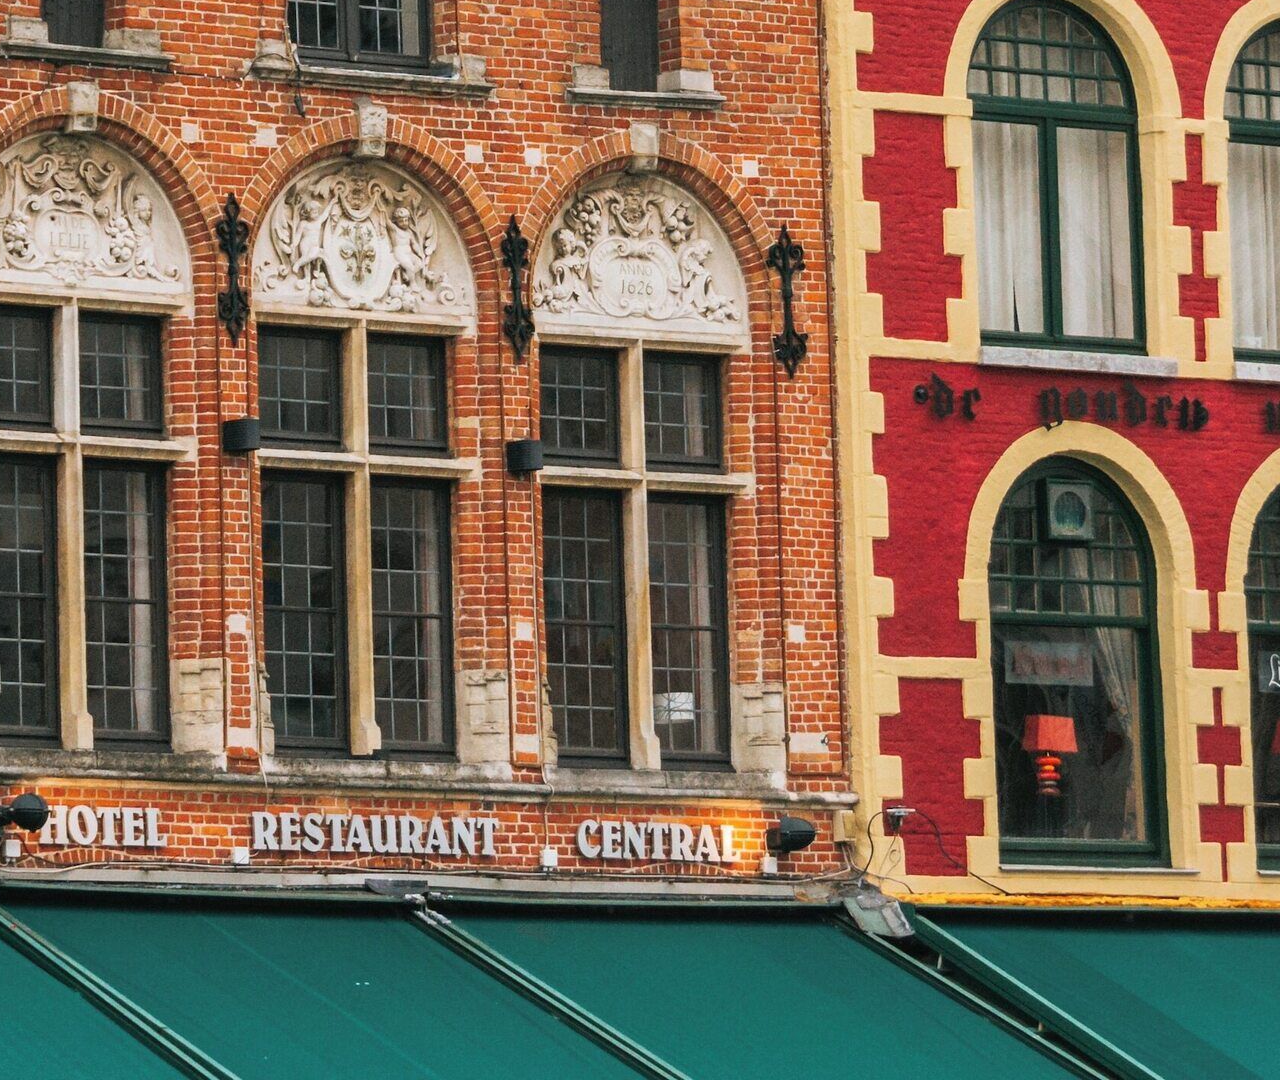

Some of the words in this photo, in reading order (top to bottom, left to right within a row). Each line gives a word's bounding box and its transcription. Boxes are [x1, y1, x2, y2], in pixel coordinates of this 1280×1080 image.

[620, 263, 652, 276] ANNO
[621, 280, 654, 296] 1626
[39, 805, 168, 847] HOTEL
[251, 811, 499, 856] RESTAURANT
[577, 819, 742, 862] CENTRAL
